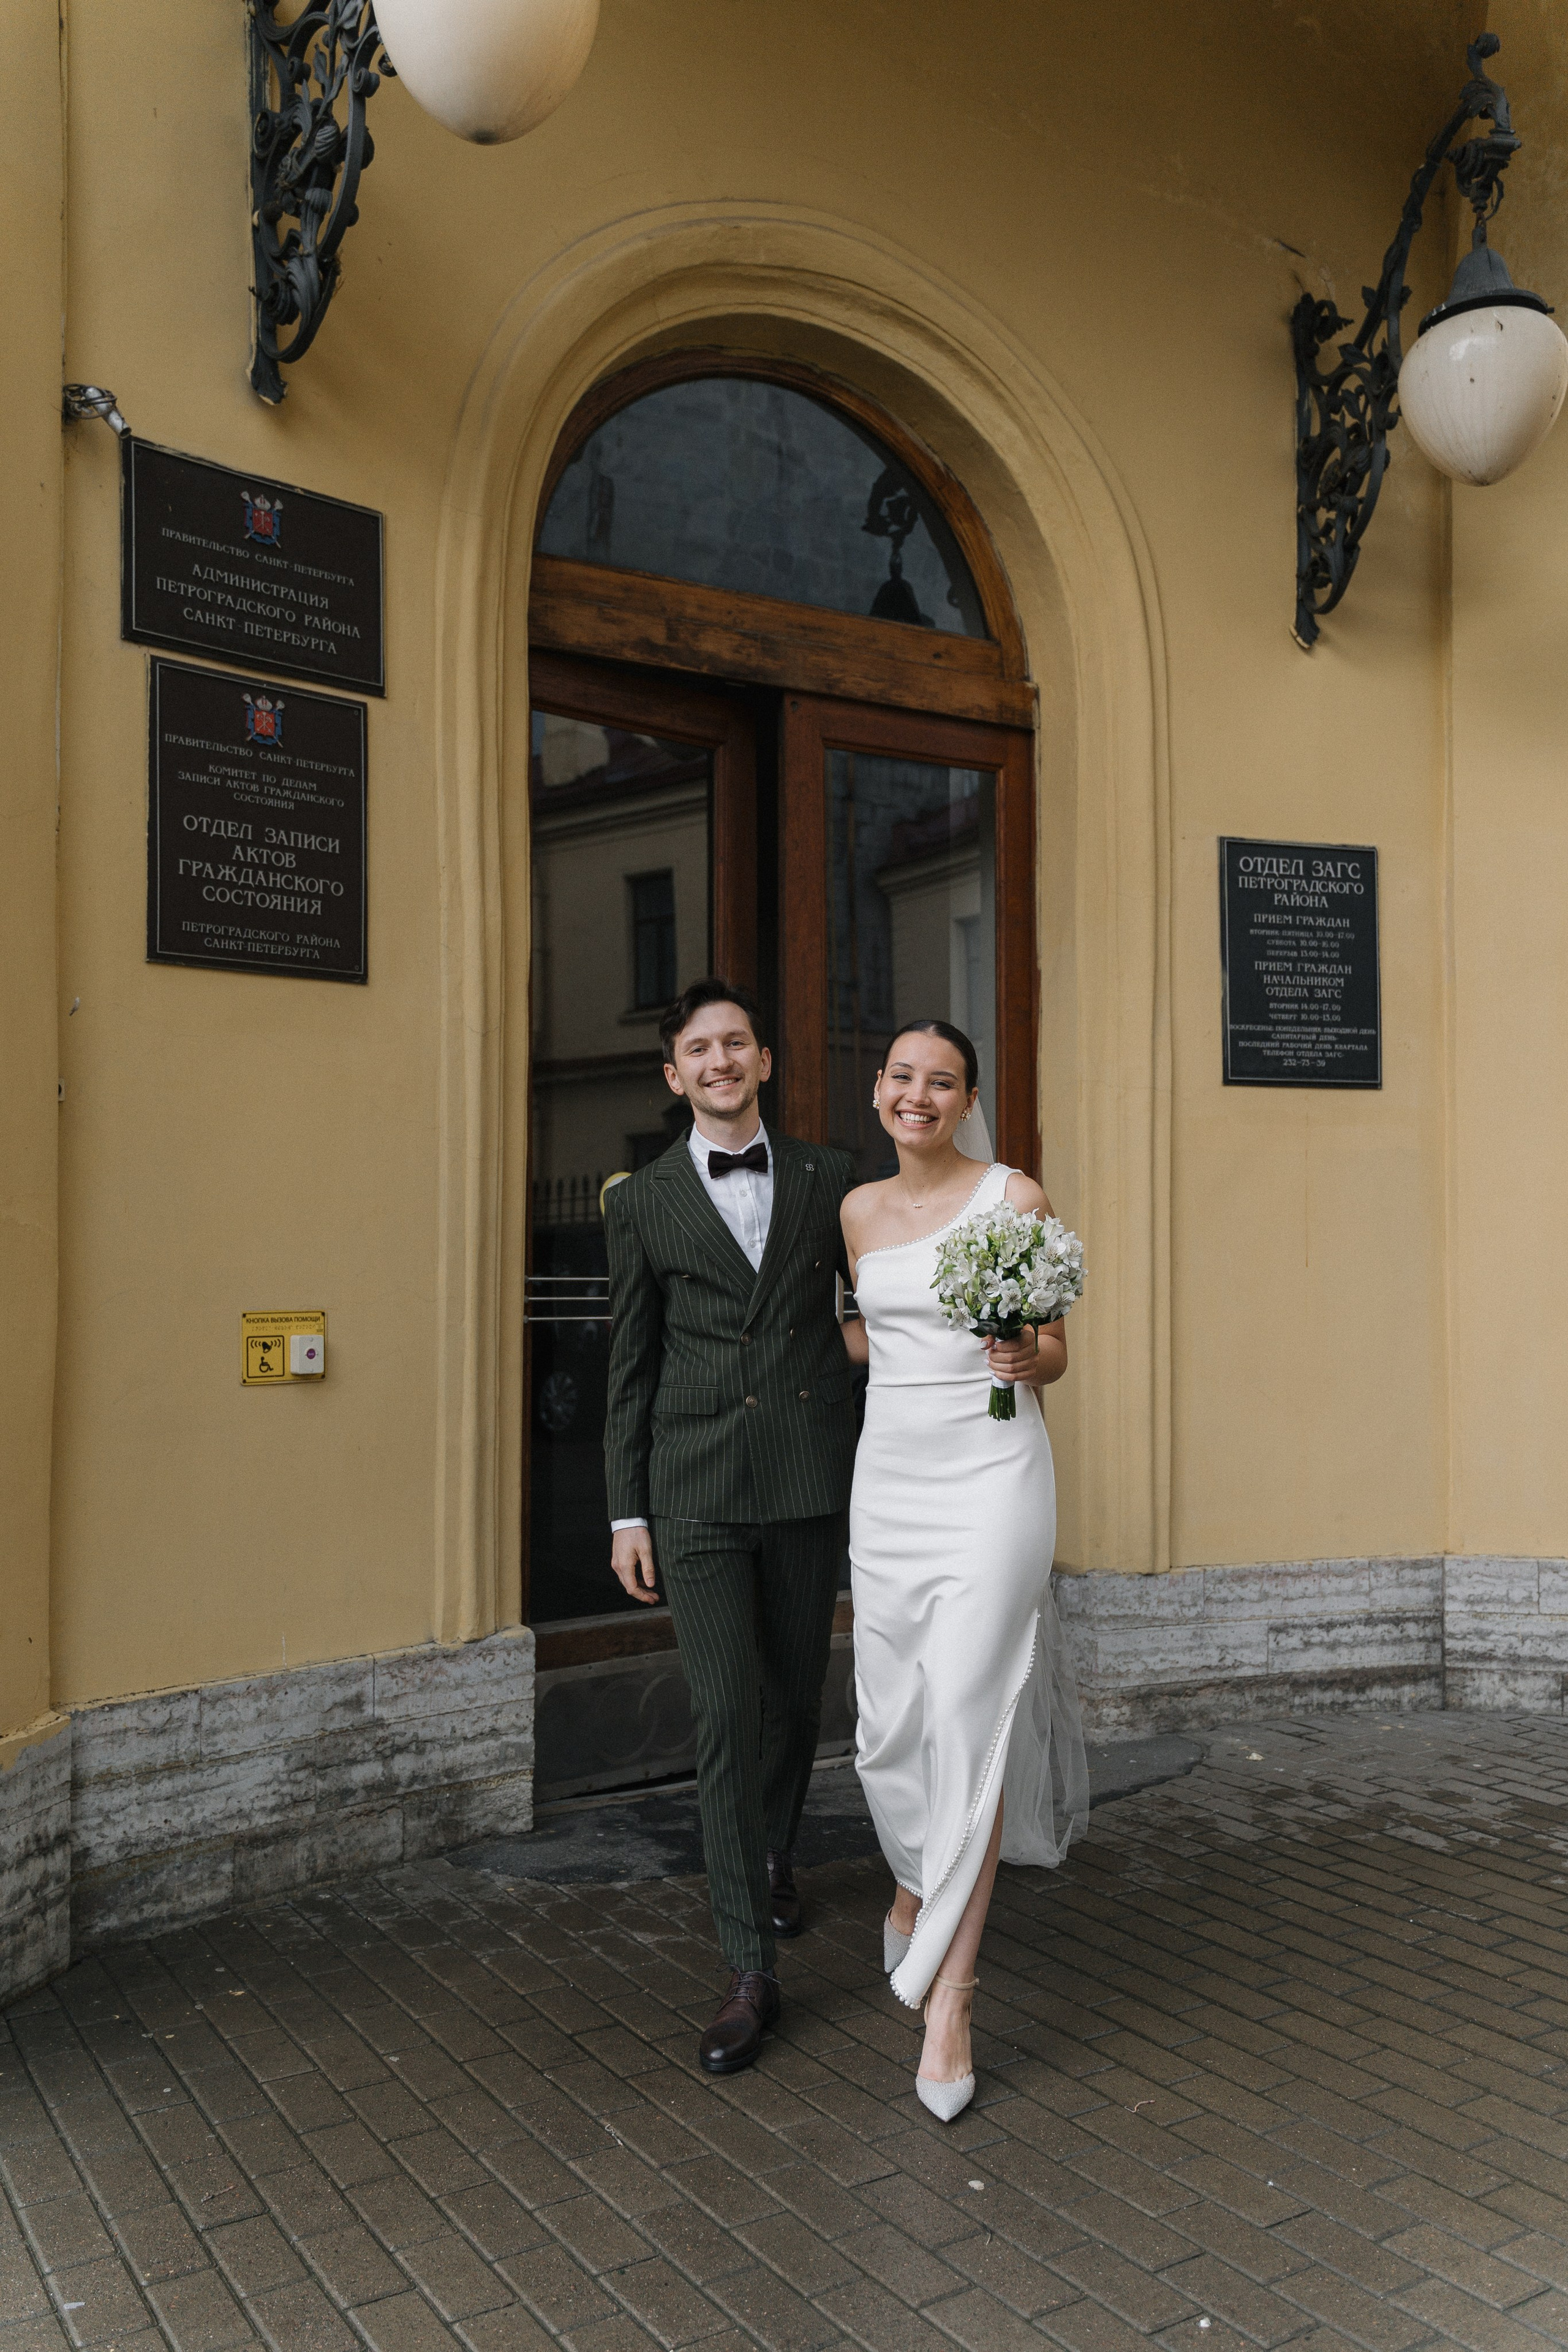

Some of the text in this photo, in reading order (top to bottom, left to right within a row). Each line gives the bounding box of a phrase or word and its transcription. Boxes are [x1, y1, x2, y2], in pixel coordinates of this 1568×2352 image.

[162, 527, 355, 586] ПРАВИТЕЛЬСТВО САНКТ-ПЕТЕРБУРГА
[192, 564, 329, 609] АДМИНИСТРАЦИЯ
[156, 576, 360, 638] ПЕТРОГРАДСКОГО РАЙОНА
[184, 608, 337, 654] САНКТ-ПЕТЕРБУРГА
[165, 733, 252, 757] ПРАВИТЕЛЬСТВО
[178, 771, 344, 807] ЗАПИСИ АКТОВ ГРАЖДАНСКОГО
[209, 765, 317, 791] КОМИТЕТ ПО ДЕЛАМ
[233, 793, 295, 810] СОСТОЯНИЯ
[183, 815, 340, 853] ОТДЕЛ ЗАПИСИ
[232, 845, 296, 868] АКТОВ
[1239, 856, 1361, 879] ОТДЕЛ ЗАГС
[178, 859, 344, 896] ГРАЖДАНСКОГО
[1238, 876, 1364, 895] ПЕТРОГРАДСКОГО
[203, 886, 322, 915] СОСТОЯНИЯ
[1274, 892, 1329, 908] РАЙОНА
[1254, 913, 1350, 928] ПРИЕМ ГРАЖДАН
[182, 921, 341, 948] ПЕТРОГРАДСКОГО РАЙОНА
[204, 938, 320, 959] САНКТ-ПЕТЕРБУРГА
[1254, 960, 1352, 974] ПРИЕМ ГРАЖДАН
[1264, 974, 1344, 987] НАЧАЛЬНИКОМ
[1265, 987, 1342, 998] ОТДЕЛА ЗАГС
